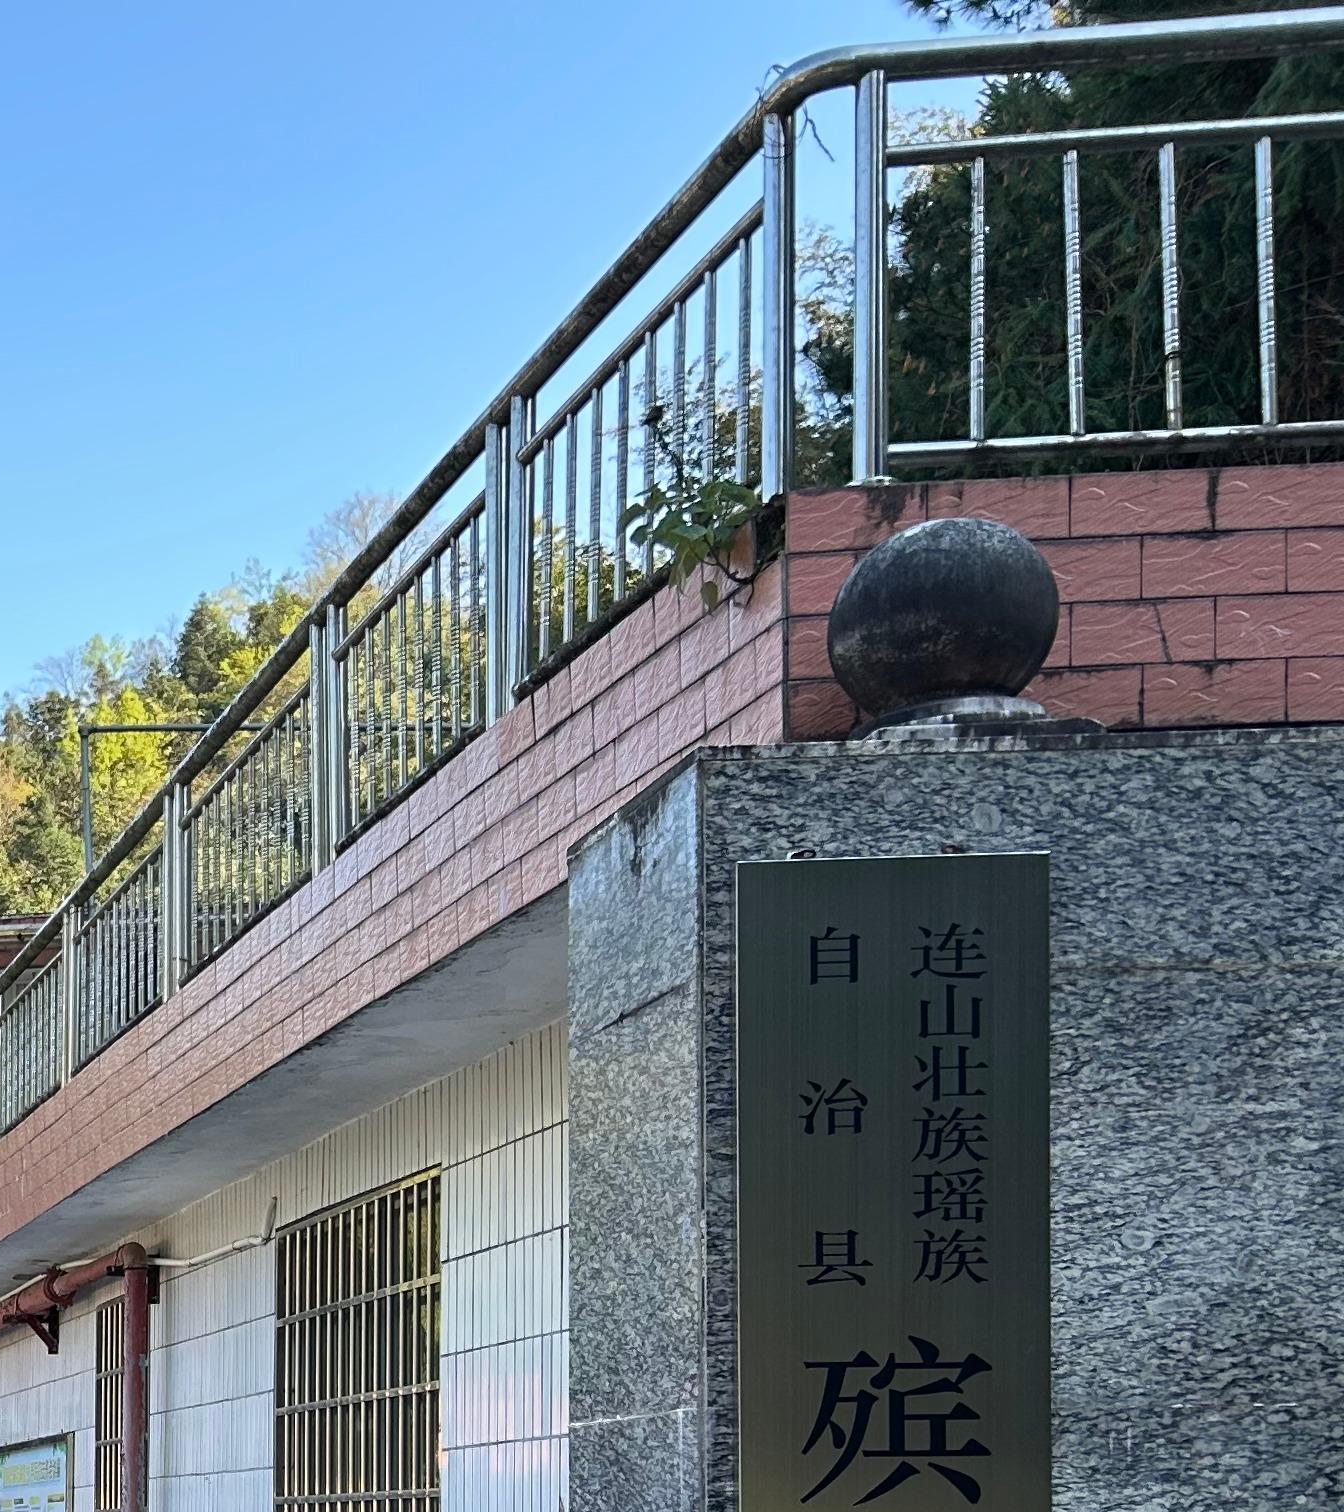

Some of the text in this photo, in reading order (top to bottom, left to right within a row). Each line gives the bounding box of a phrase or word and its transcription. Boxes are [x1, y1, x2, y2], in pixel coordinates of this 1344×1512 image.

[798, 926, 874, 1287] 自治县
[910, 922, 990, 1285] 连山壮族瑶族
